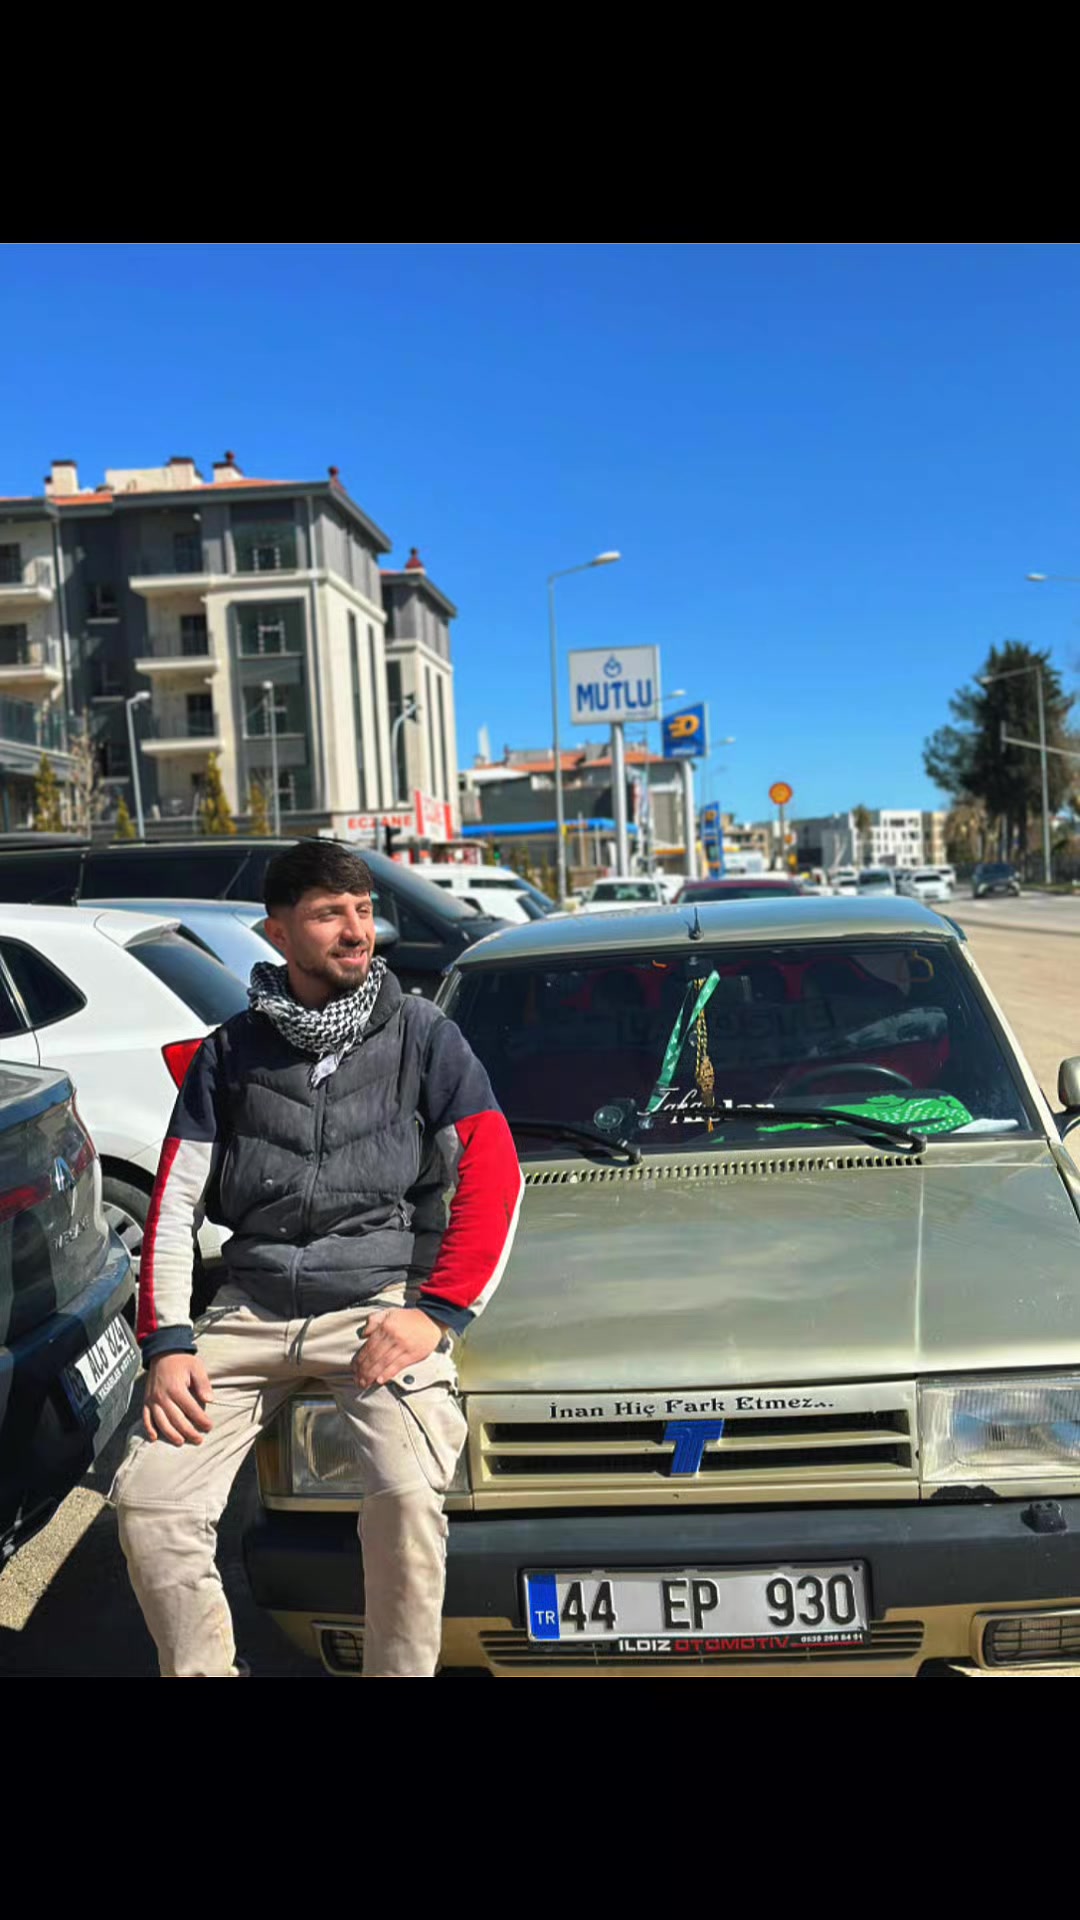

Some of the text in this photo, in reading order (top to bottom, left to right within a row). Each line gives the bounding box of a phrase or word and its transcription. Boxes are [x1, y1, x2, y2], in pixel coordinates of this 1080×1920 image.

[576, 678, 653, 713] MUTLU
[549, 1402, 604, 1419] İnan
[614, 1401, 656, 1417] Hiç
[664, 1398, 725, 1414] Fark
[534, 1574, 857, 1631] TR 44 EP 930
